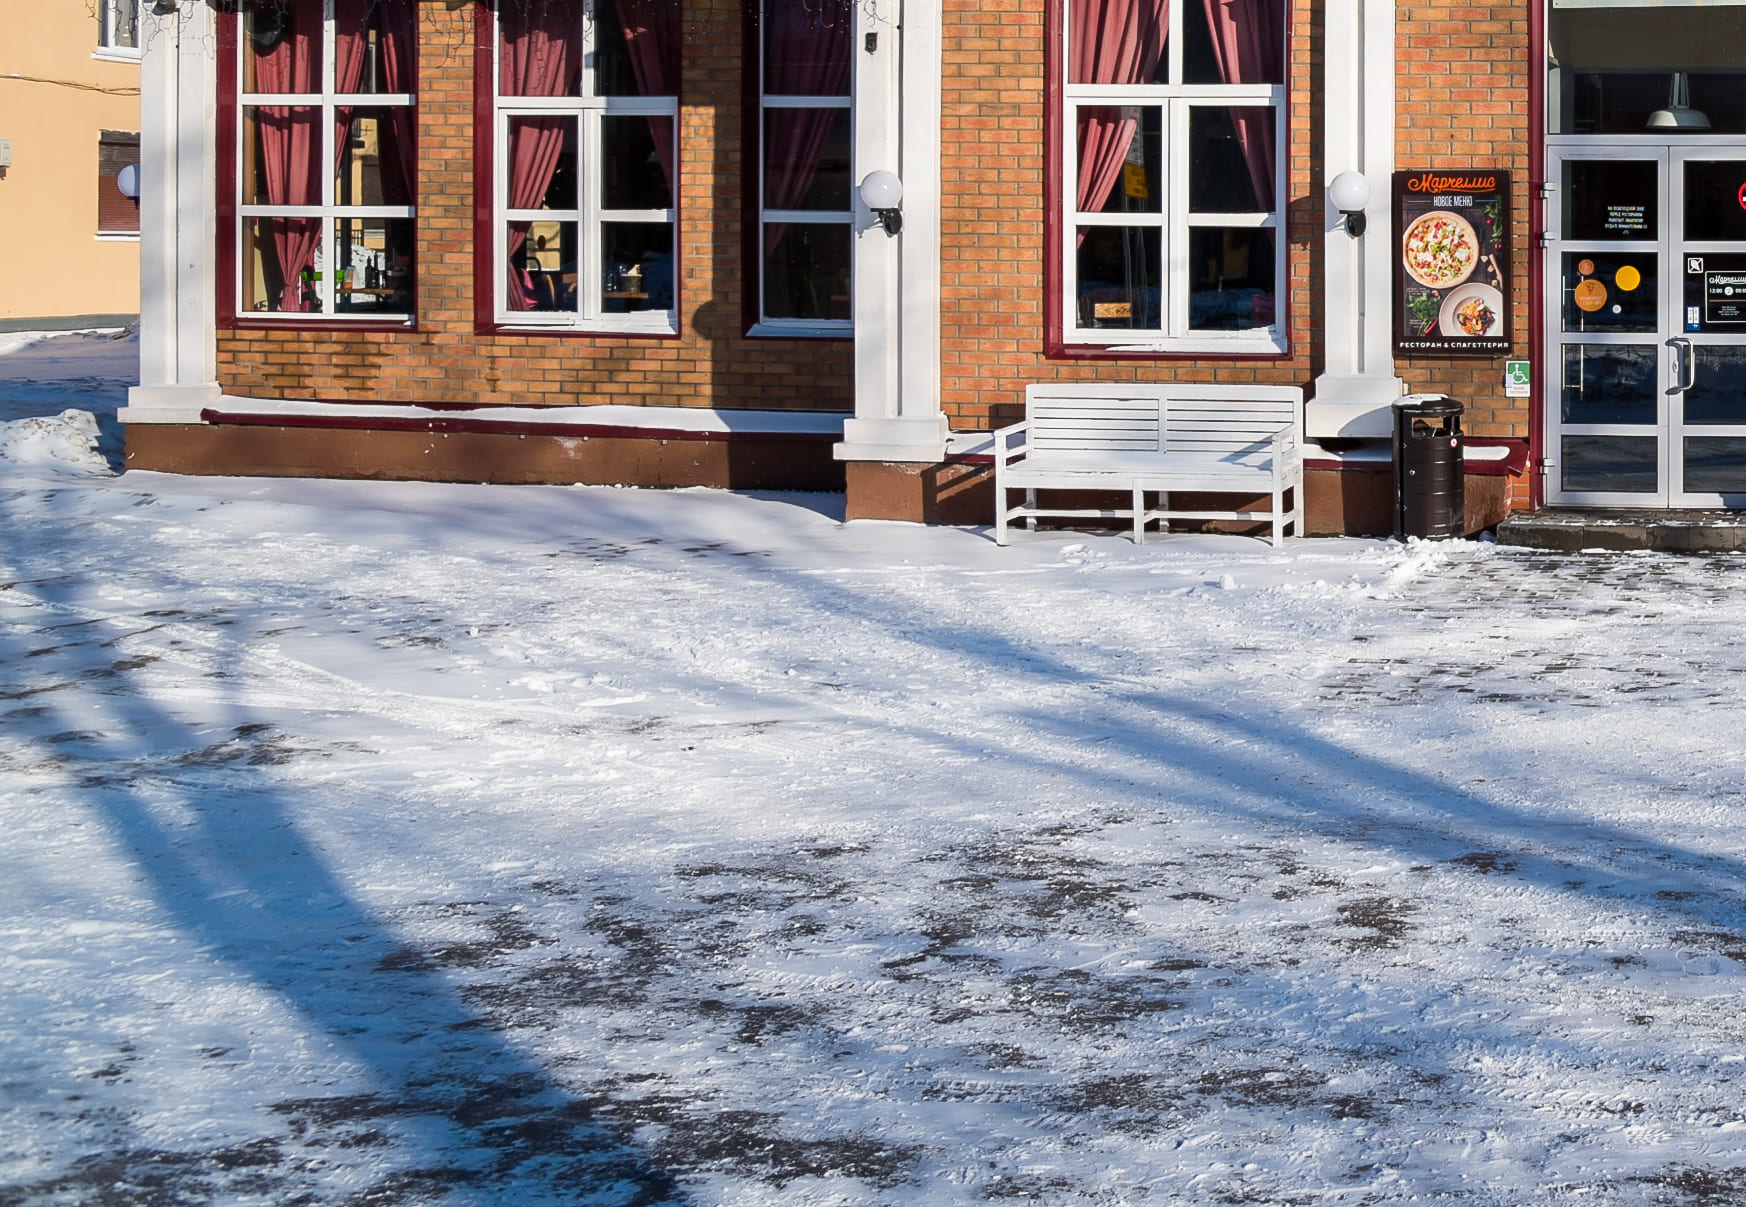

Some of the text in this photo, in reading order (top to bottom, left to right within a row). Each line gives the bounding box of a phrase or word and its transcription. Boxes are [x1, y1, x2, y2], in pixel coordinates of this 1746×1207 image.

[1408, 173, 1496, 193] Марчеллис
[1433, 195, 1473, 207] НОВОЕ МЕНЮ
